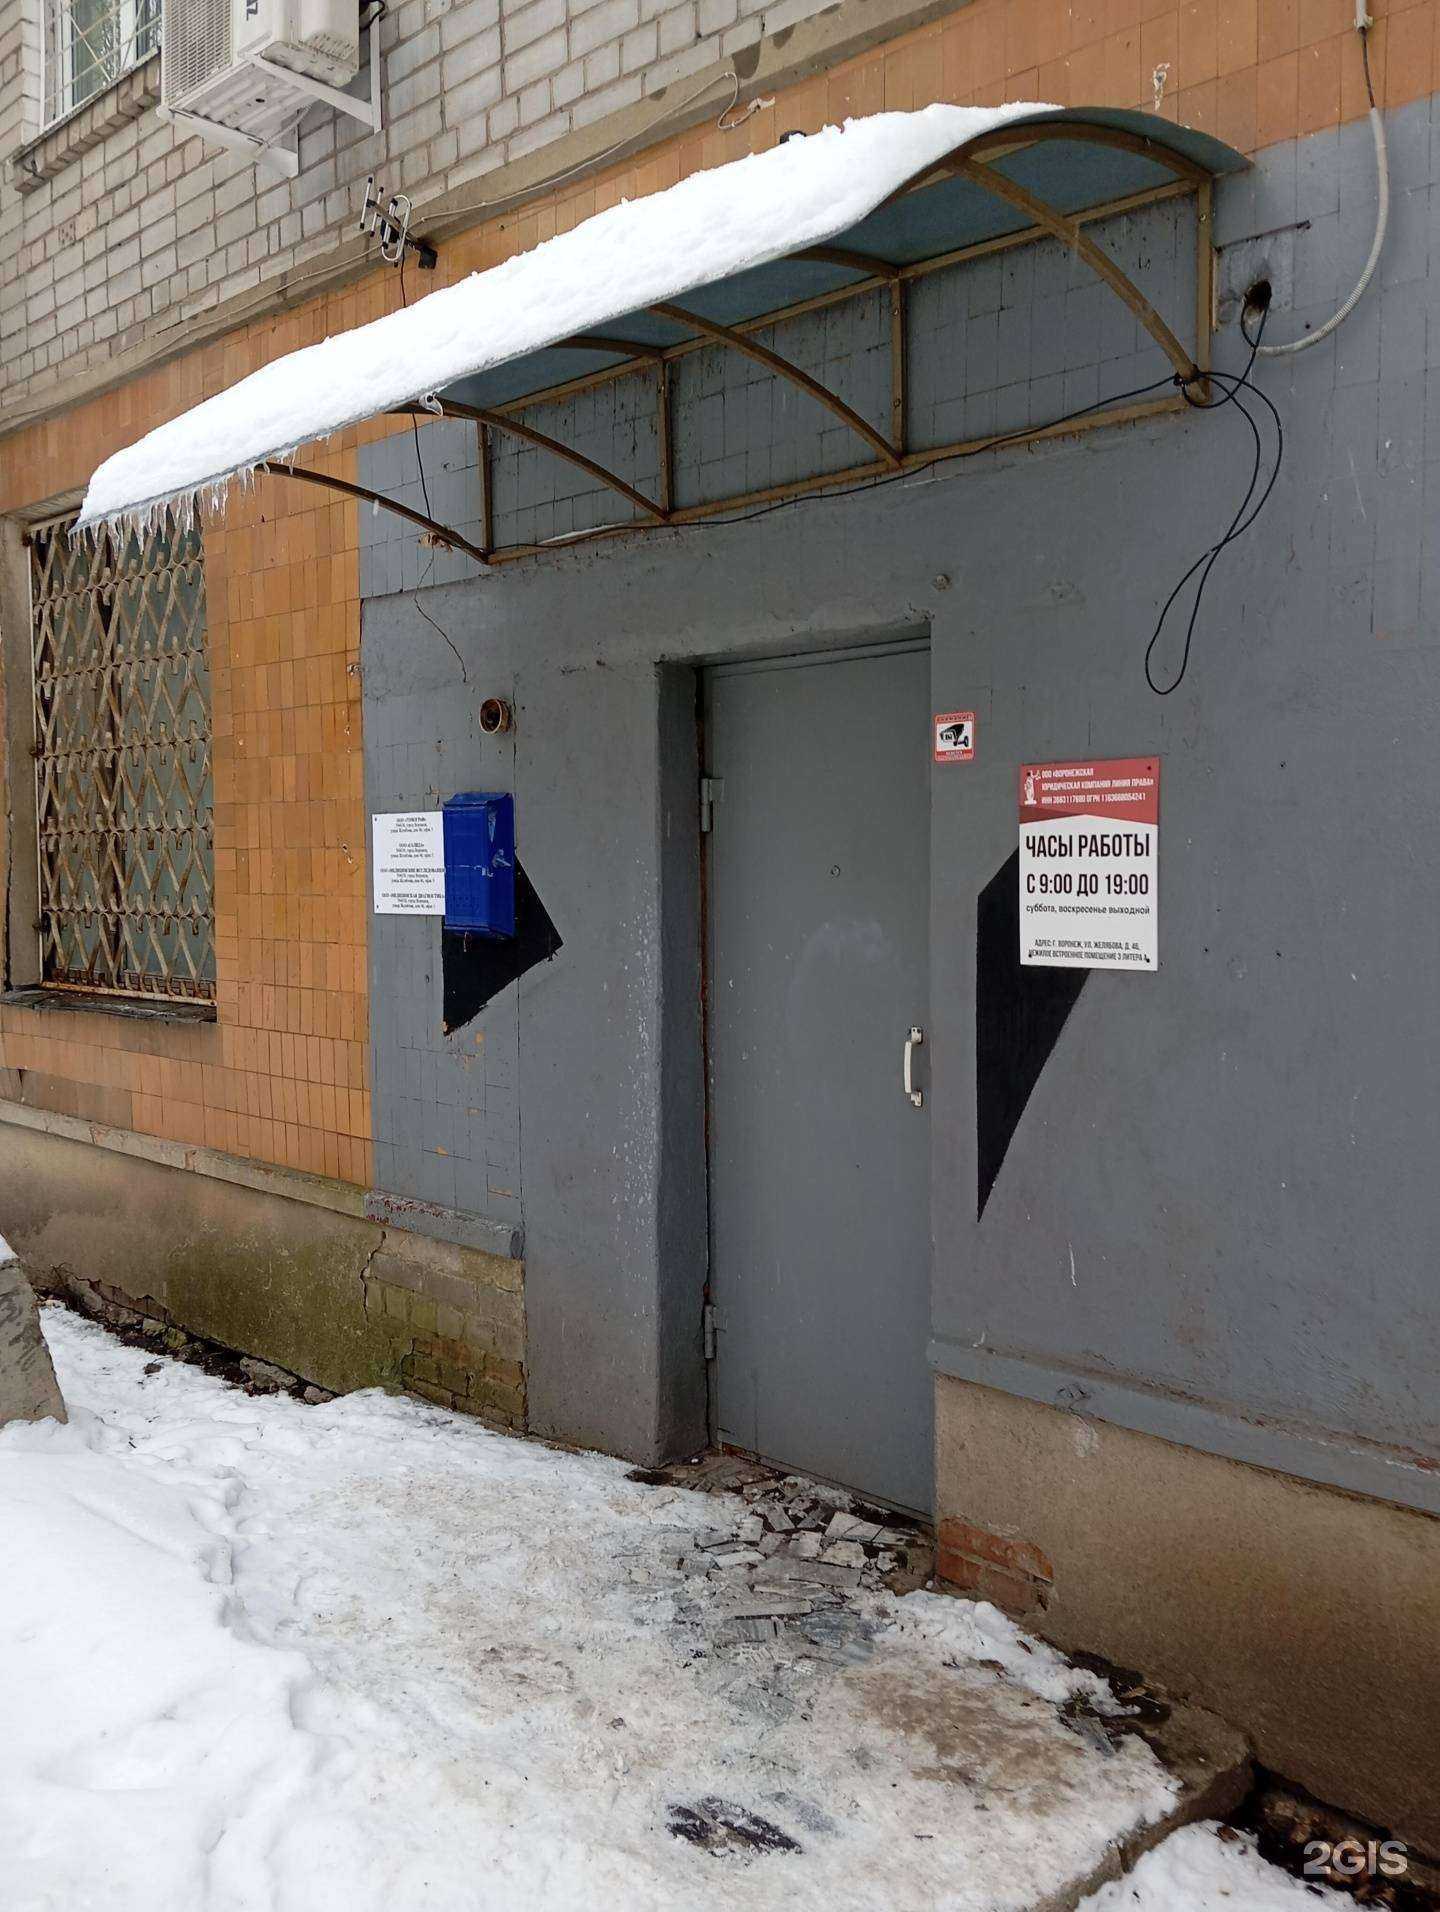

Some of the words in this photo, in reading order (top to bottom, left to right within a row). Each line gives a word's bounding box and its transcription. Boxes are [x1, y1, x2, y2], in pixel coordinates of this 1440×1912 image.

[1026, 834, 1073, 858] ЧАСЫ
[1078, 833, 1150, 857] РАБОТЫ
[1026, 873, 1036, 894] С
[1039, 873, 1073, 894] 9:00
[1076, 873, 1099, 897] ДО
[1104, 873, 1149, 895] 19:00
[1026, 903, 1058, 914] суббота,
[1058, 904, 1107, 915] воскресенье
[1108, 904, 1150, 915] выходной
